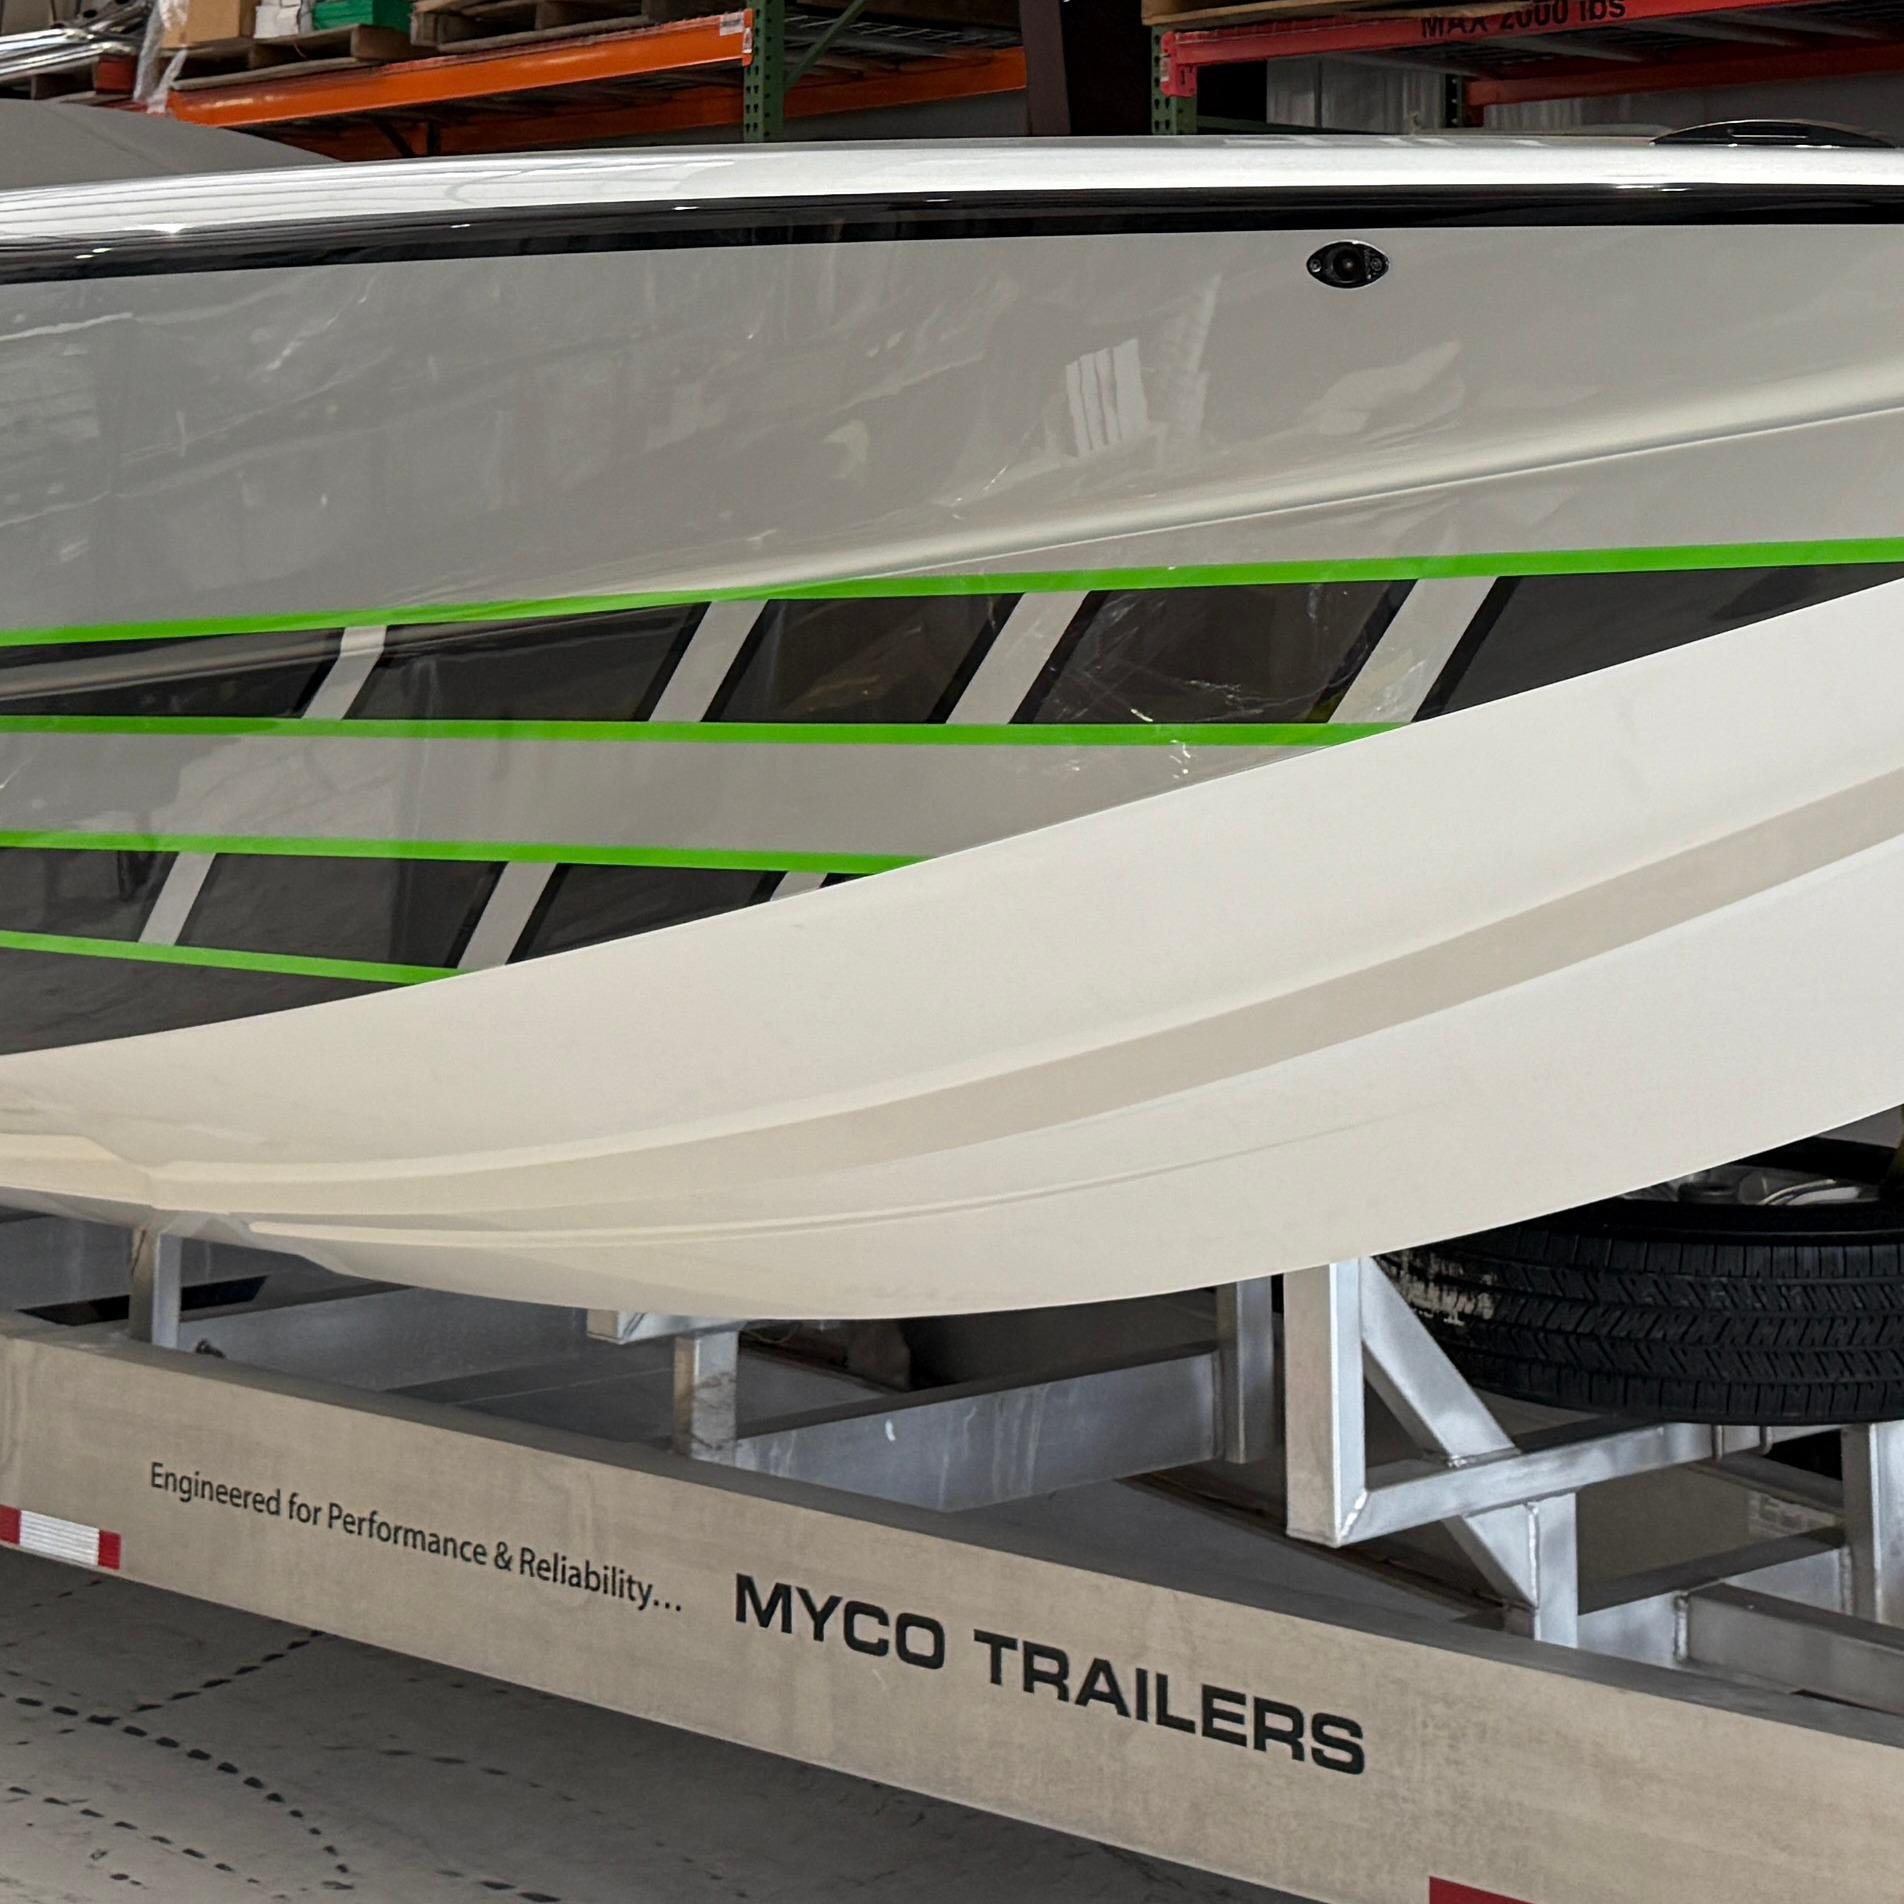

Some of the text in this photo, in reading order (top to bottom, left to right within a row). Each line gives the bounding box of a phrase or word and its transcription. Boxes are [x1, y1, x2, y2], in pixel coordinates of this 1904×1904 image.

[150, 1461, 282, 1503] Engineered
[288, 1492, 322, 1526] for
[328, 1501, 487, 1565] Performance
[493, 1540, 513, 1572] &
[734, 1572, 1366, 1776] MYCO TRAILERS
